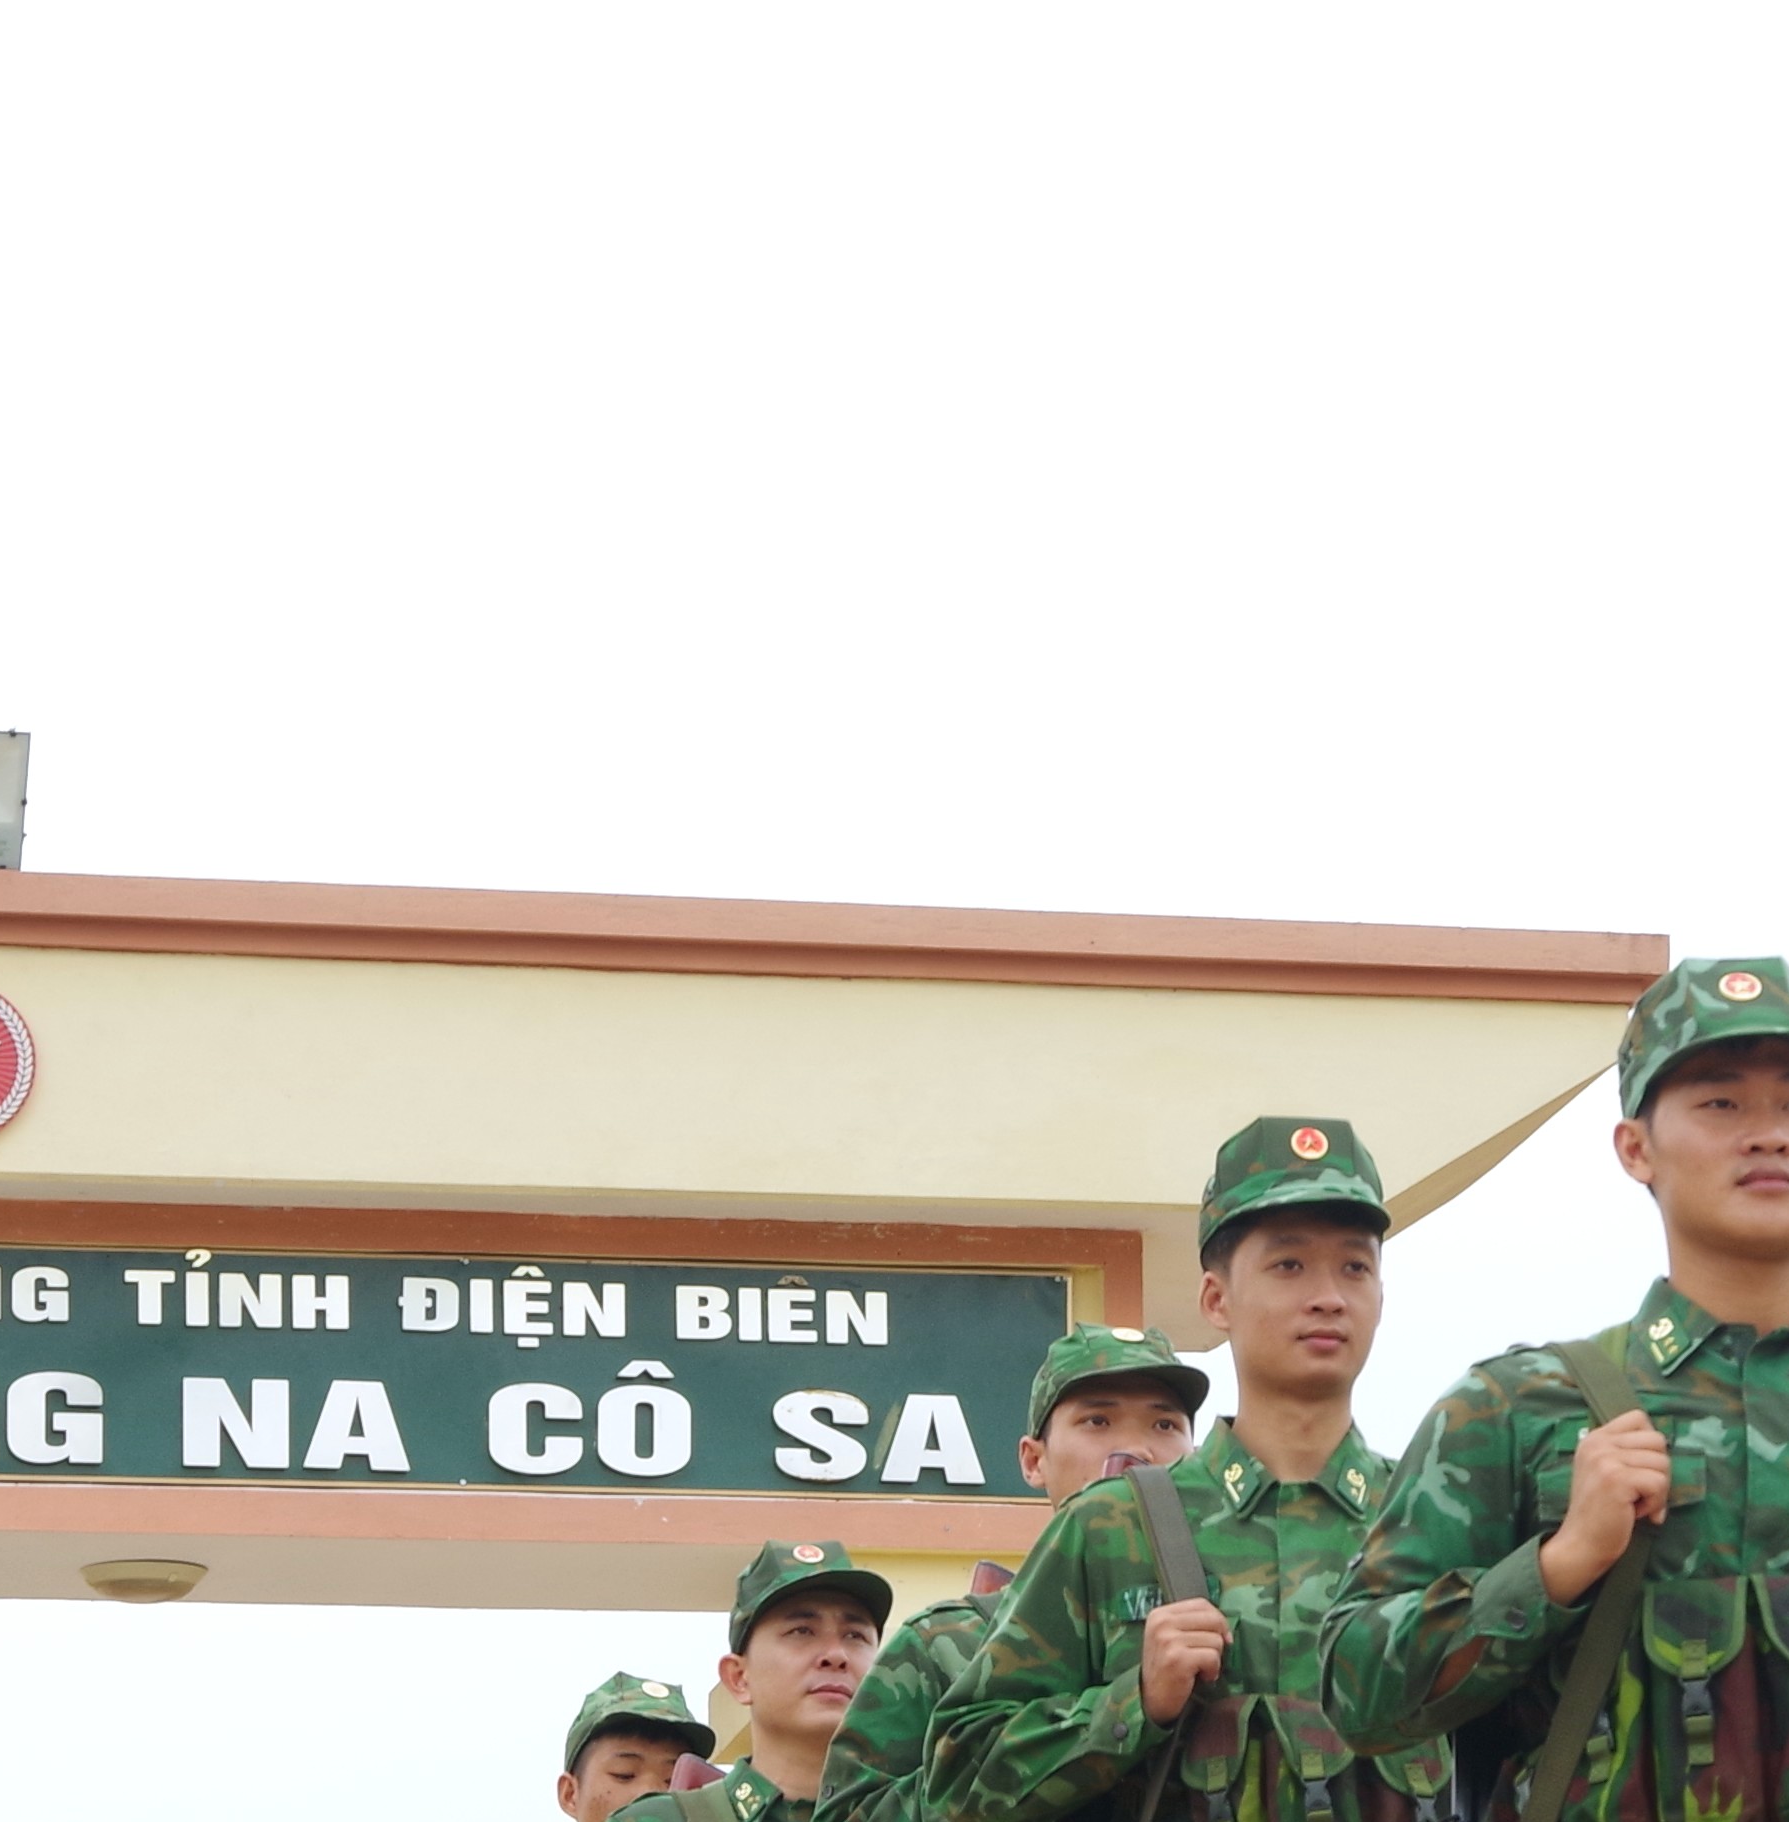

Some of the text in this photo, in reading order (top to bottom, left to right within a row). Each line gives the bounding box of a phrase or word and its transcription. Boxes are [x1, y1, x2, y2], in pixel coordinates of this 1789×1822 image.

[123, 1249, 350, 1330] TỈNH
[397, 1265, 627, 1348] ĐIỆN
[675, 1275, 889, 1346] BIÊN
[182, 1376, 411, 1472] NA
[488, 1359, 692, 1477] CÔ
[772, 1389, 986, 1485] SA
